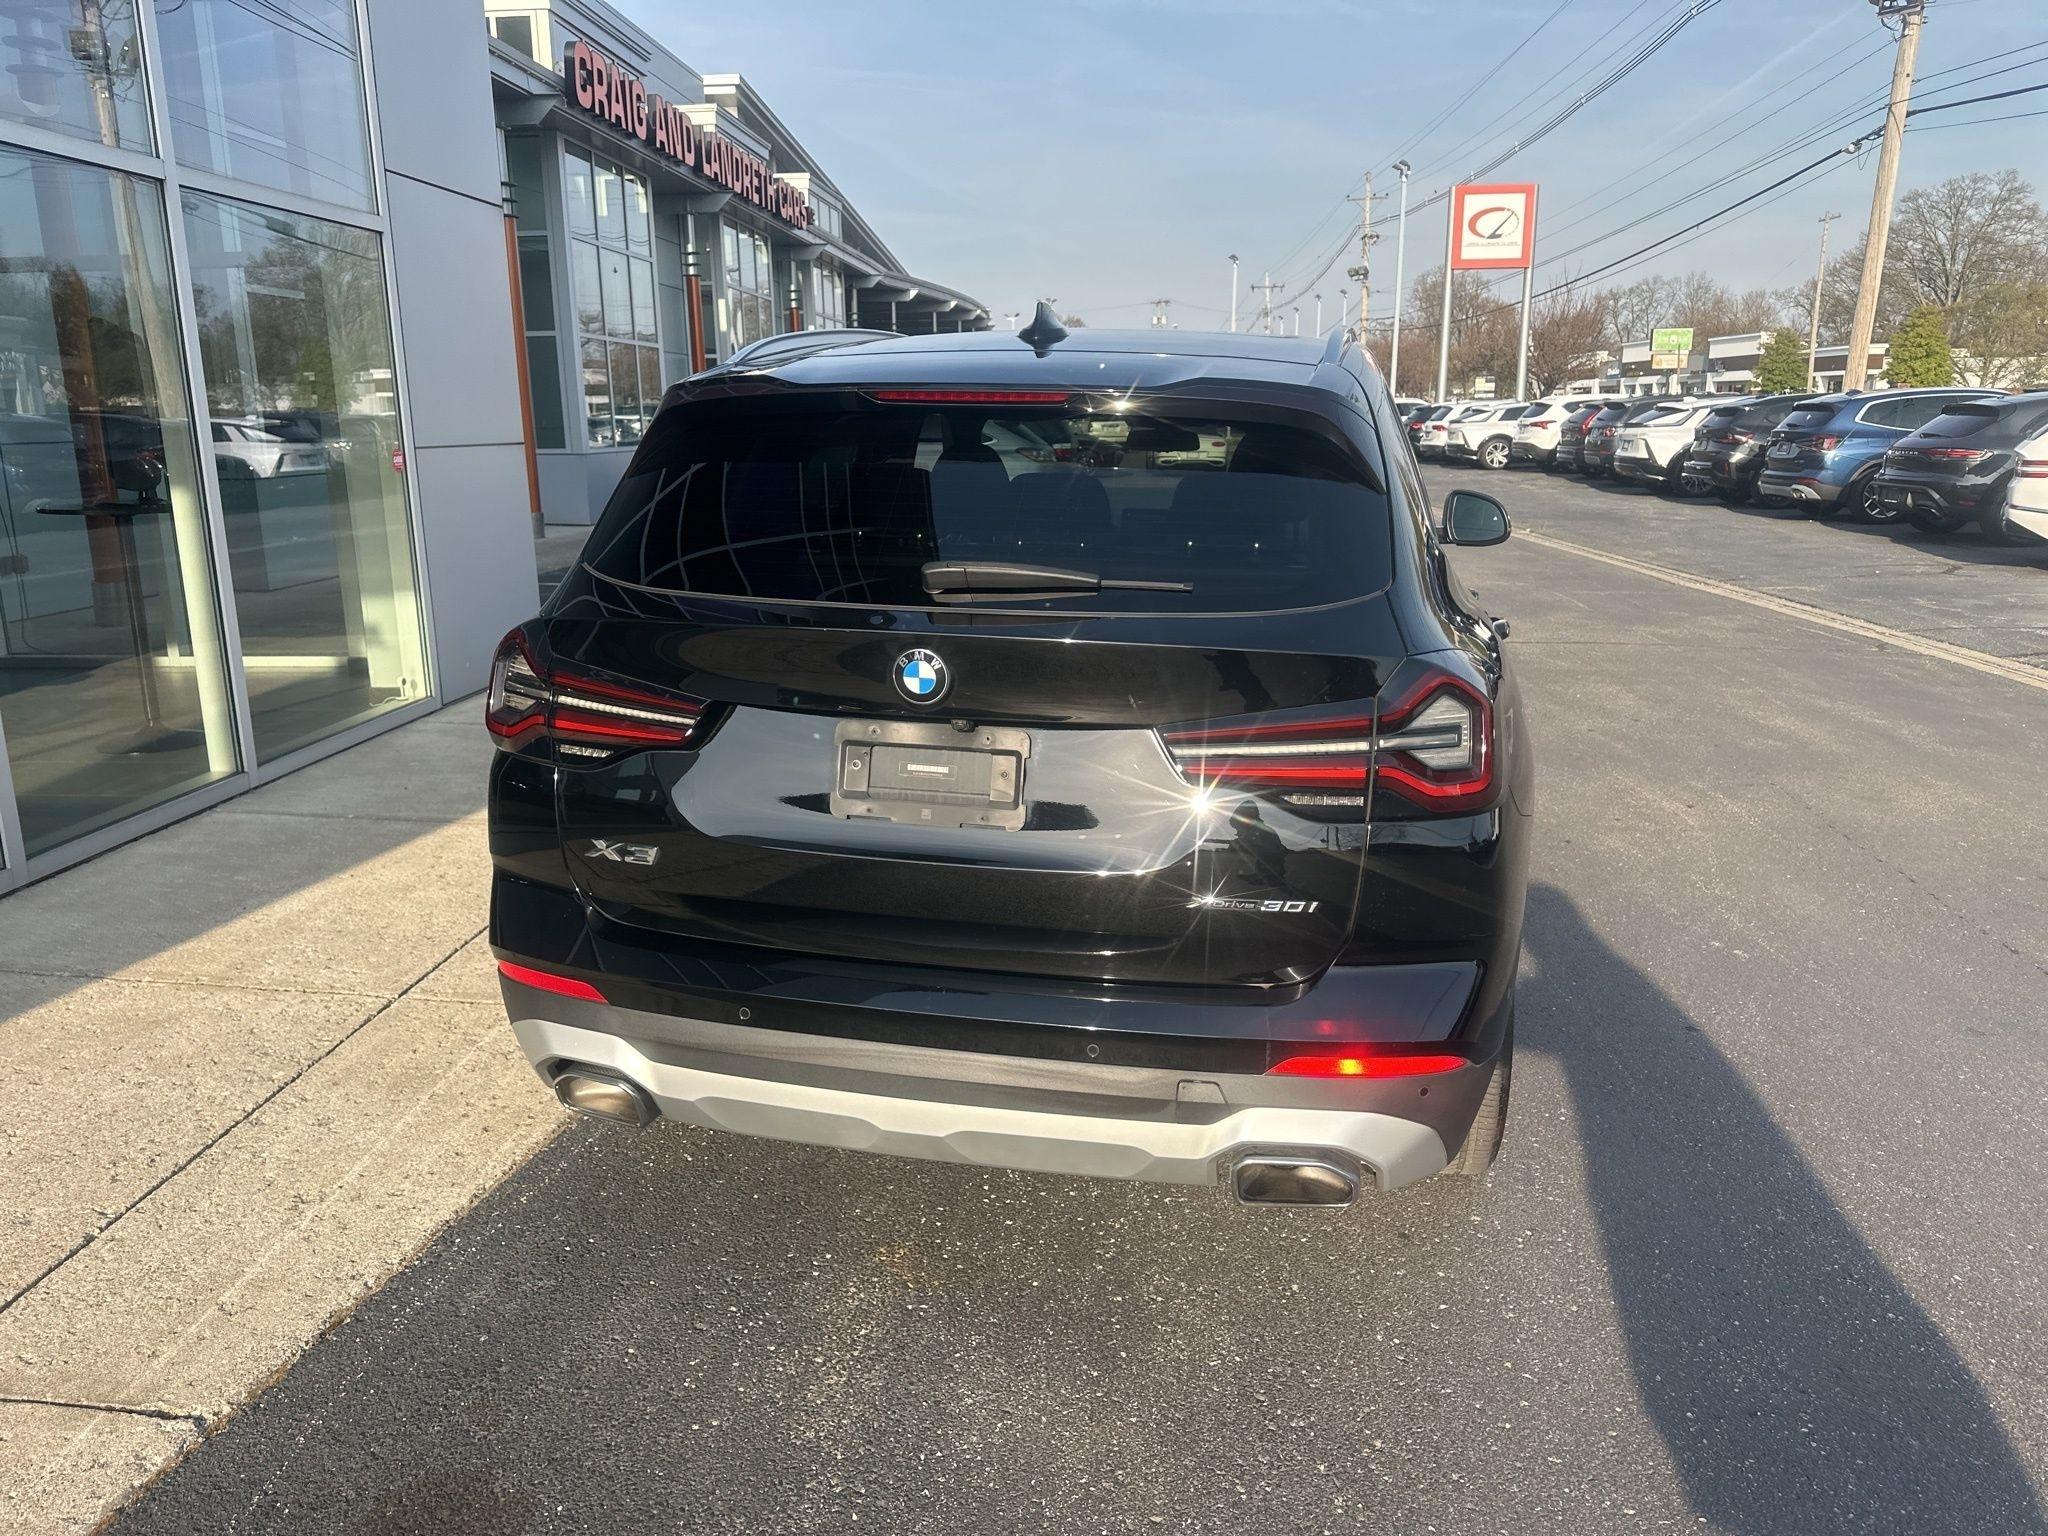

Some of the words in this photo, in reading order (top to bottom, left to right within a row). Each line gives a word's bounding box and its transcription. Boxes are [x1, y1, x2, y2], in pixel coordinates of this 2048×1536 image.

[573, 41, 647, 140] CRAIG
[655, 95, 695, 167] AND
[701, 126, 776, 213] LANDRETH
[779, 177, 808, 230] CARS
[899, 651, 942, 670] BMW
[584, 839, 658, 866] X3
